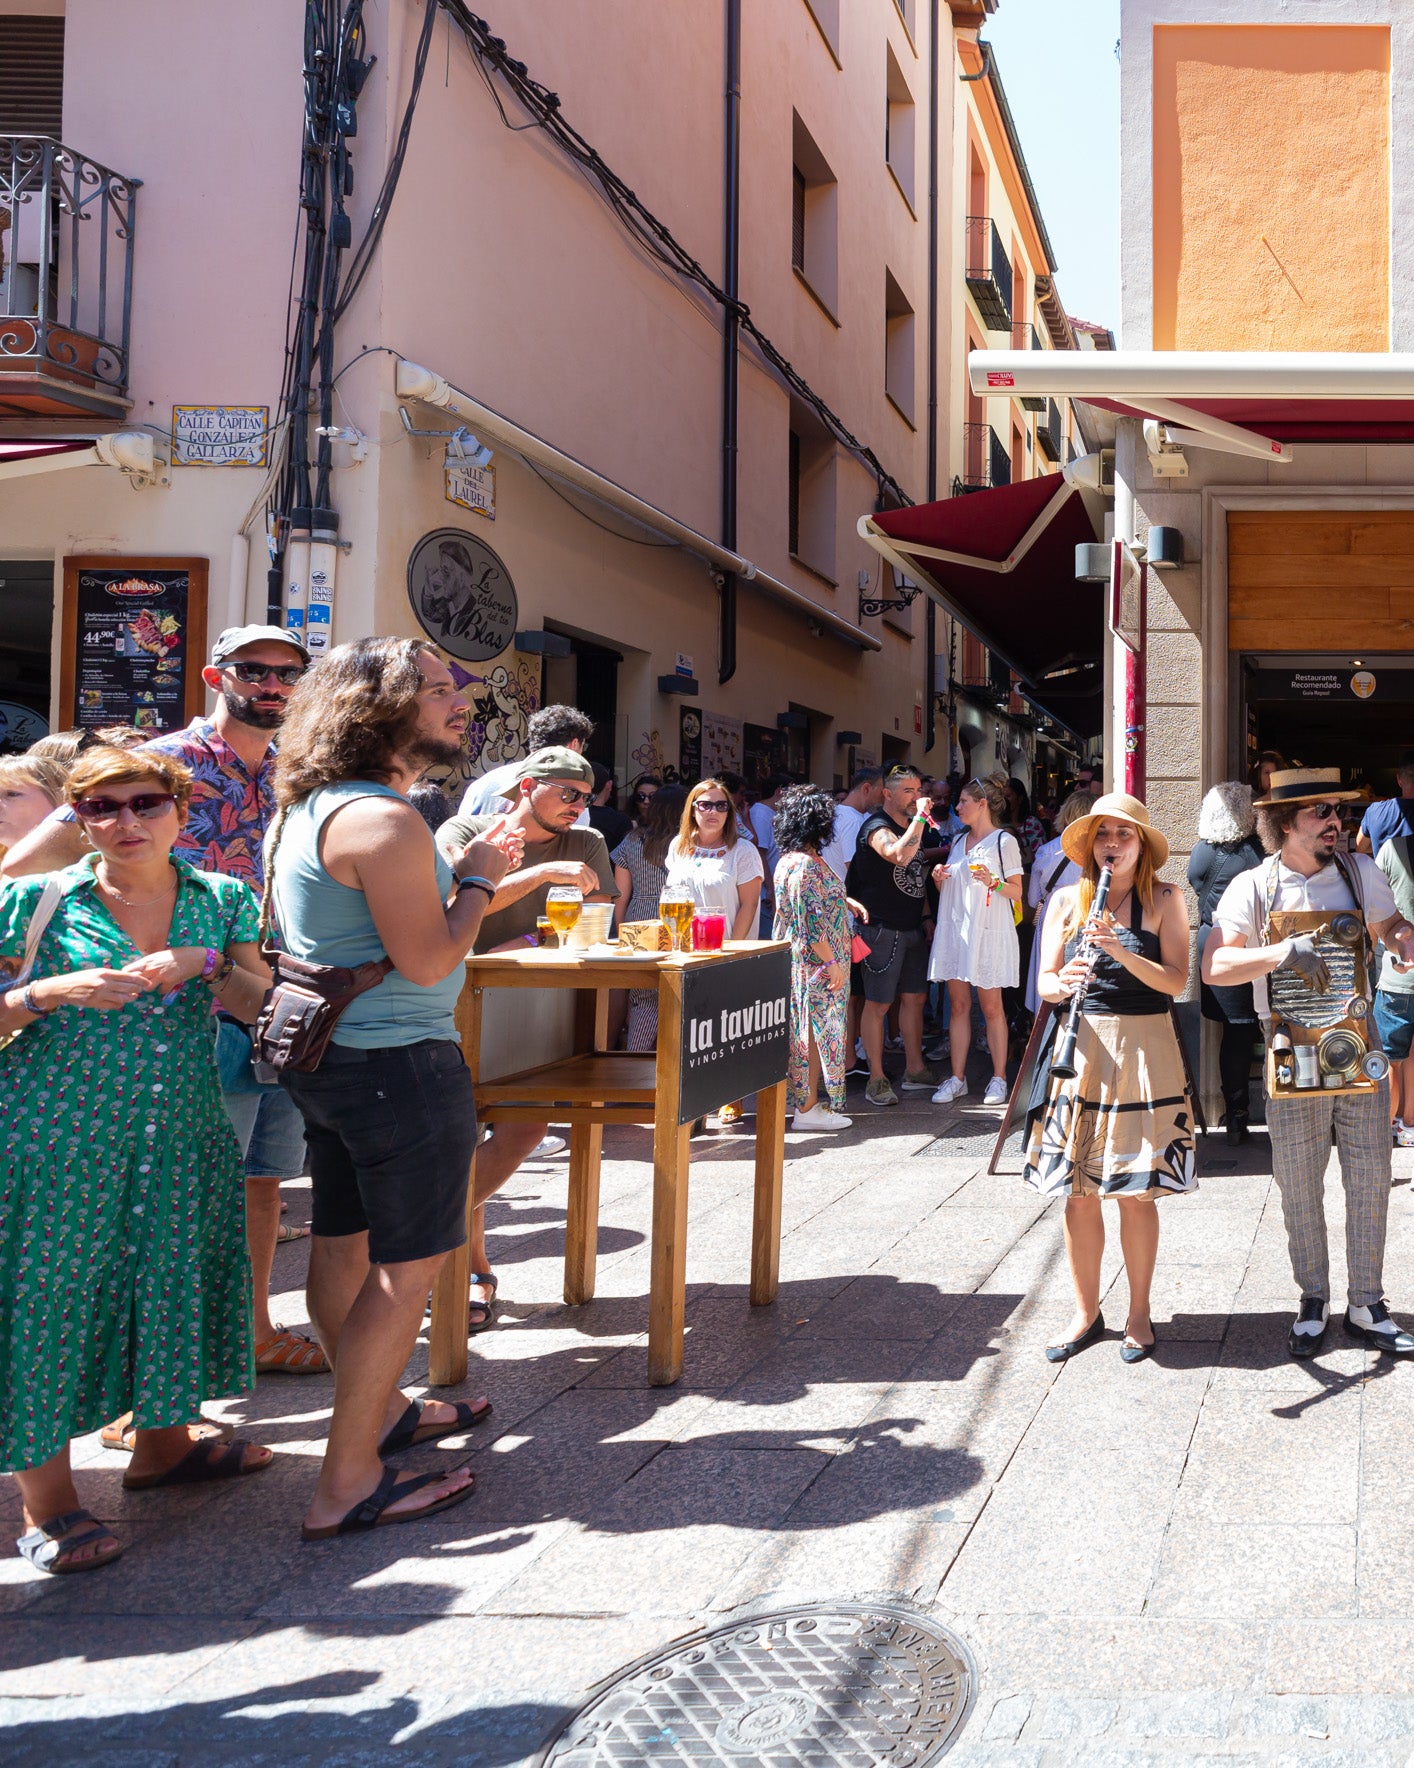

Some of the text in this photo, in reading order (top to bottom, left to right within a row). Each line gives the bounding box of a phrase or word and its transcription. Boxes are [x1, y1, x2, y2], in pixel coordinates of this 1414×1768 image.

[179, 415, 261, 429] CALLE CAPITÁN
[189, 429, 256, 444] GONZÁLEZ
[187, 444, 254, 458] GALLARZA
[464, 478, 480, 491] DEL
[454, 480, 489, 509] LAUREL
[131, 583, 160, 591] BRASA
[471, 562, 499, 594] La
[477, 593, 513, 616] taberna
[447, 607, 503, 649] Blas
[1291, 681, 1342, 689] Recomendado
[689, 997, 786, 1054] la tavina
[689, 1027, 785, 1068] VINOS Y COMIDAS
